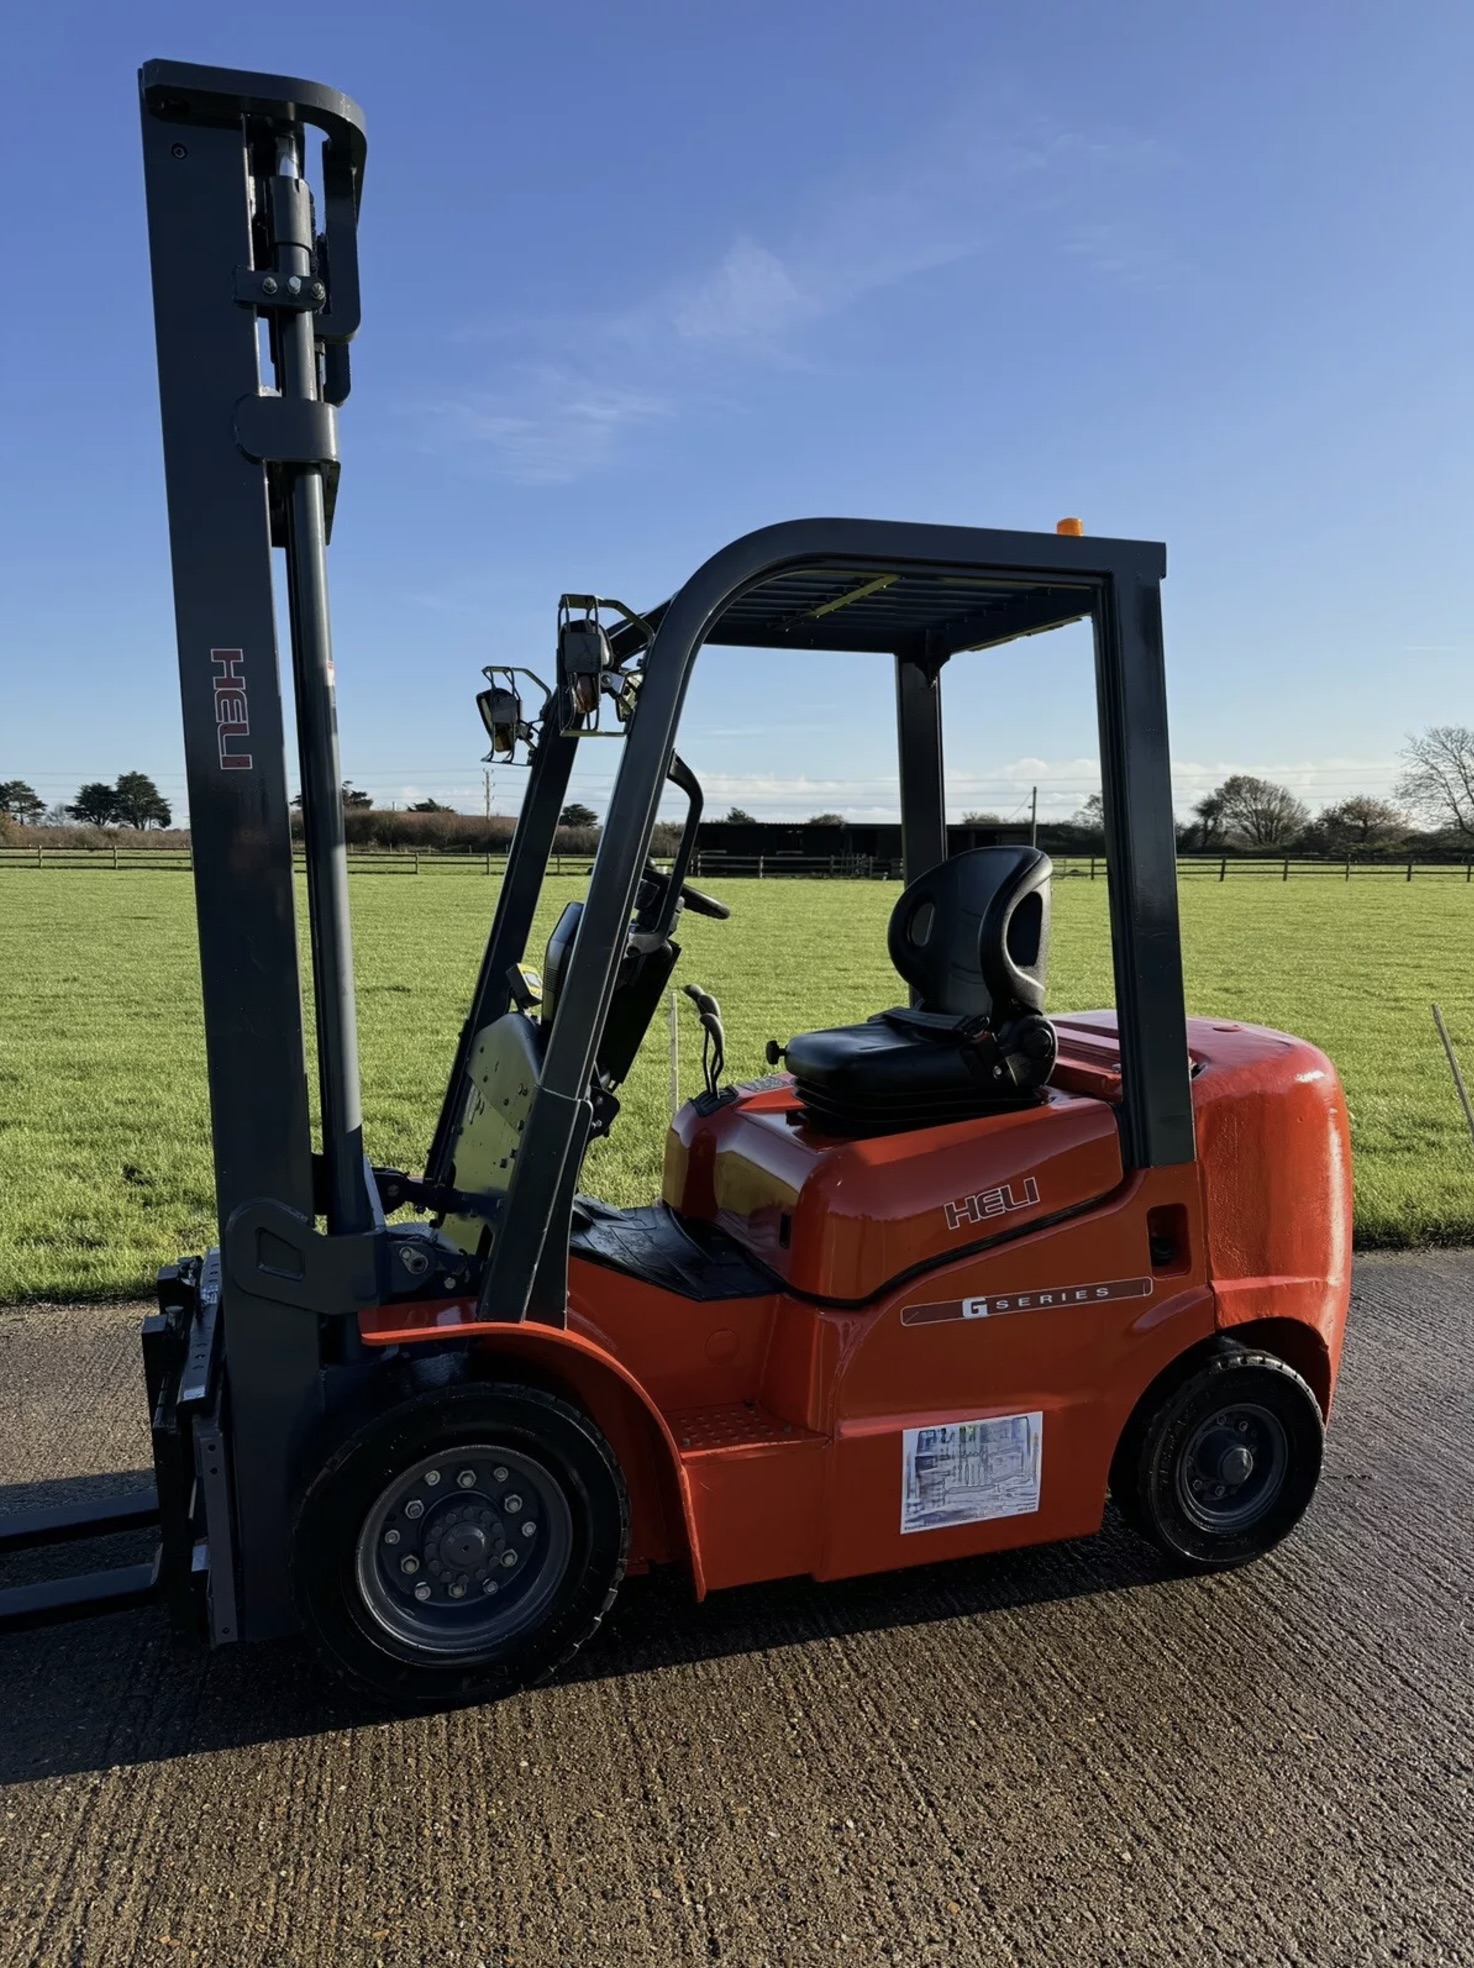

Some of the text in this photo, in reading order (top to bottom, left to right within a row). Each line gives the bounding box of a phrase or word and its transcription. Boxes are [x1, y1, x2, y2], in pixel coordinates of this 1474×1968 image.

[210, 648, 253, 770] HELI
[944, 1176, 1041, 1230] HELI
[962, 1287, 1109, 1319] G SERIES
